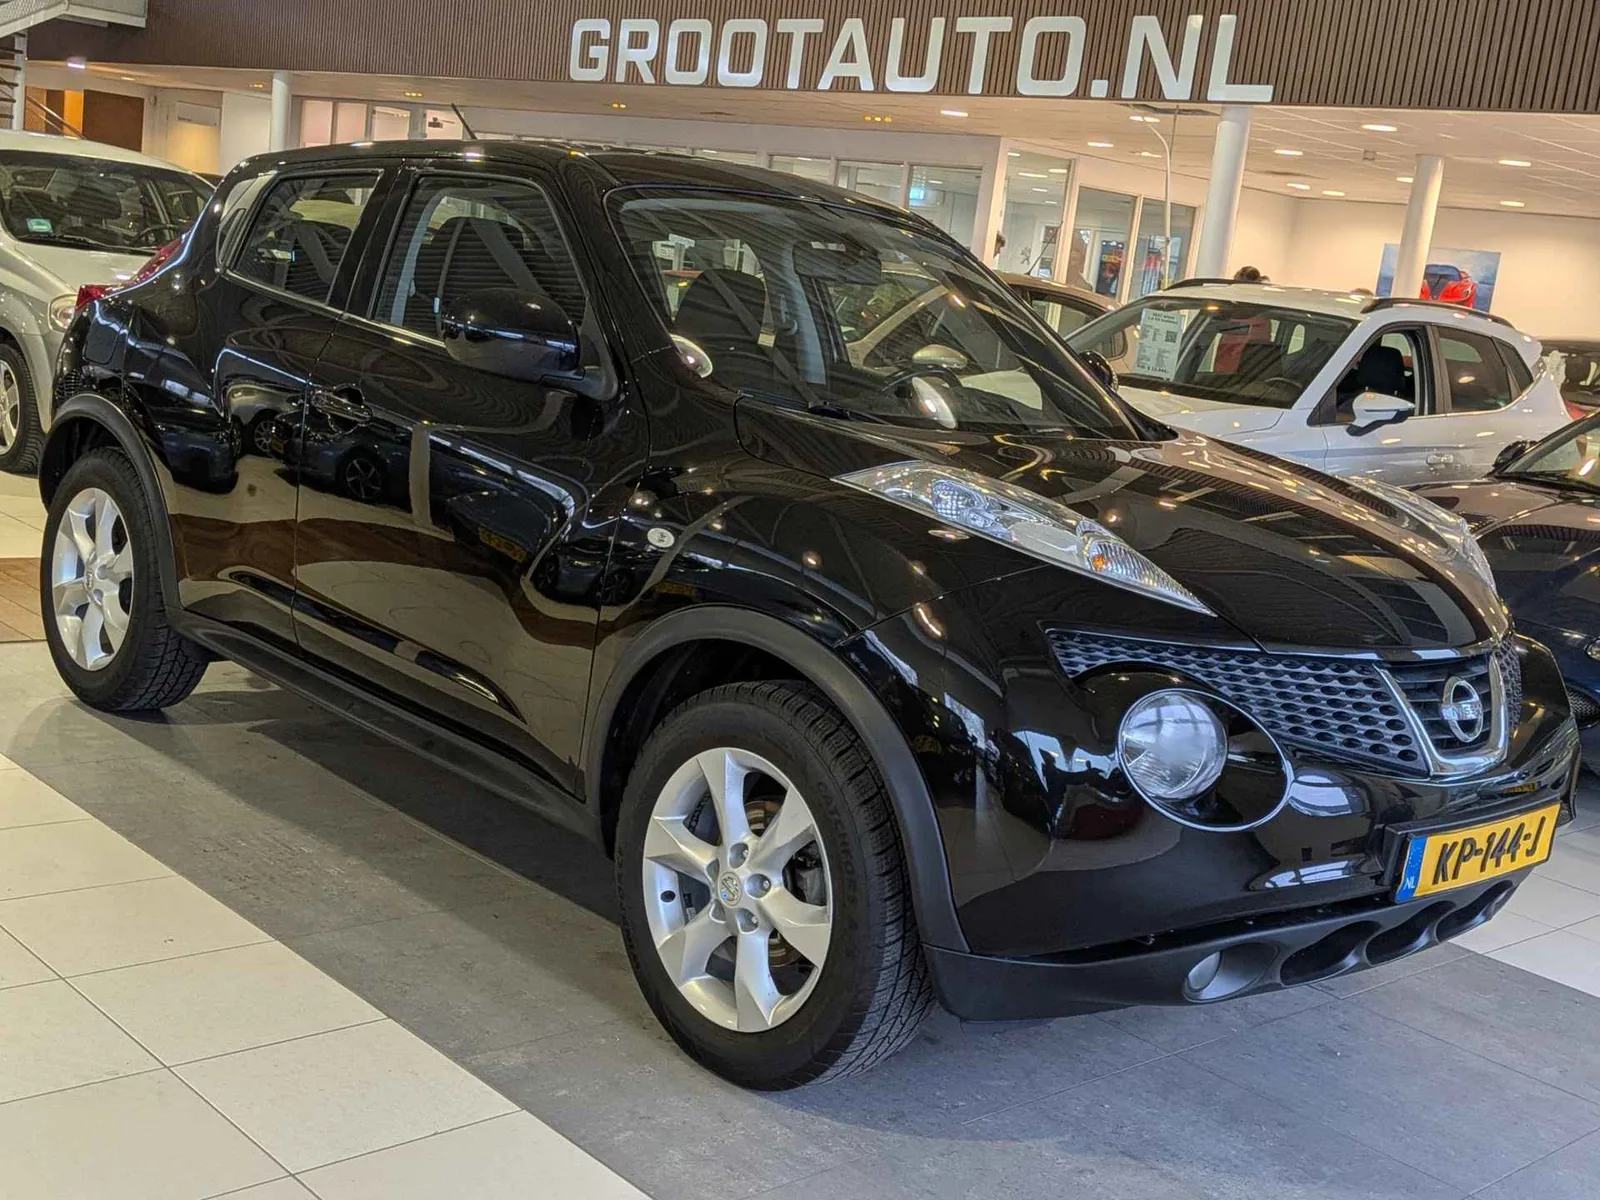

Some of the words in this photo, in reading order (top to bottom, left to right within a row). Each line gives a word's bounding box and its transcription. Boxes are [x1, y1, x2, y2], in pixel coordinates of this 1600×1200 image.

[570, 14, 1273, 101] GROOTAUTO.NL
[1402, 877, 1416, 889] NL
[1432, 815, 1547, 885] KP-144-J
